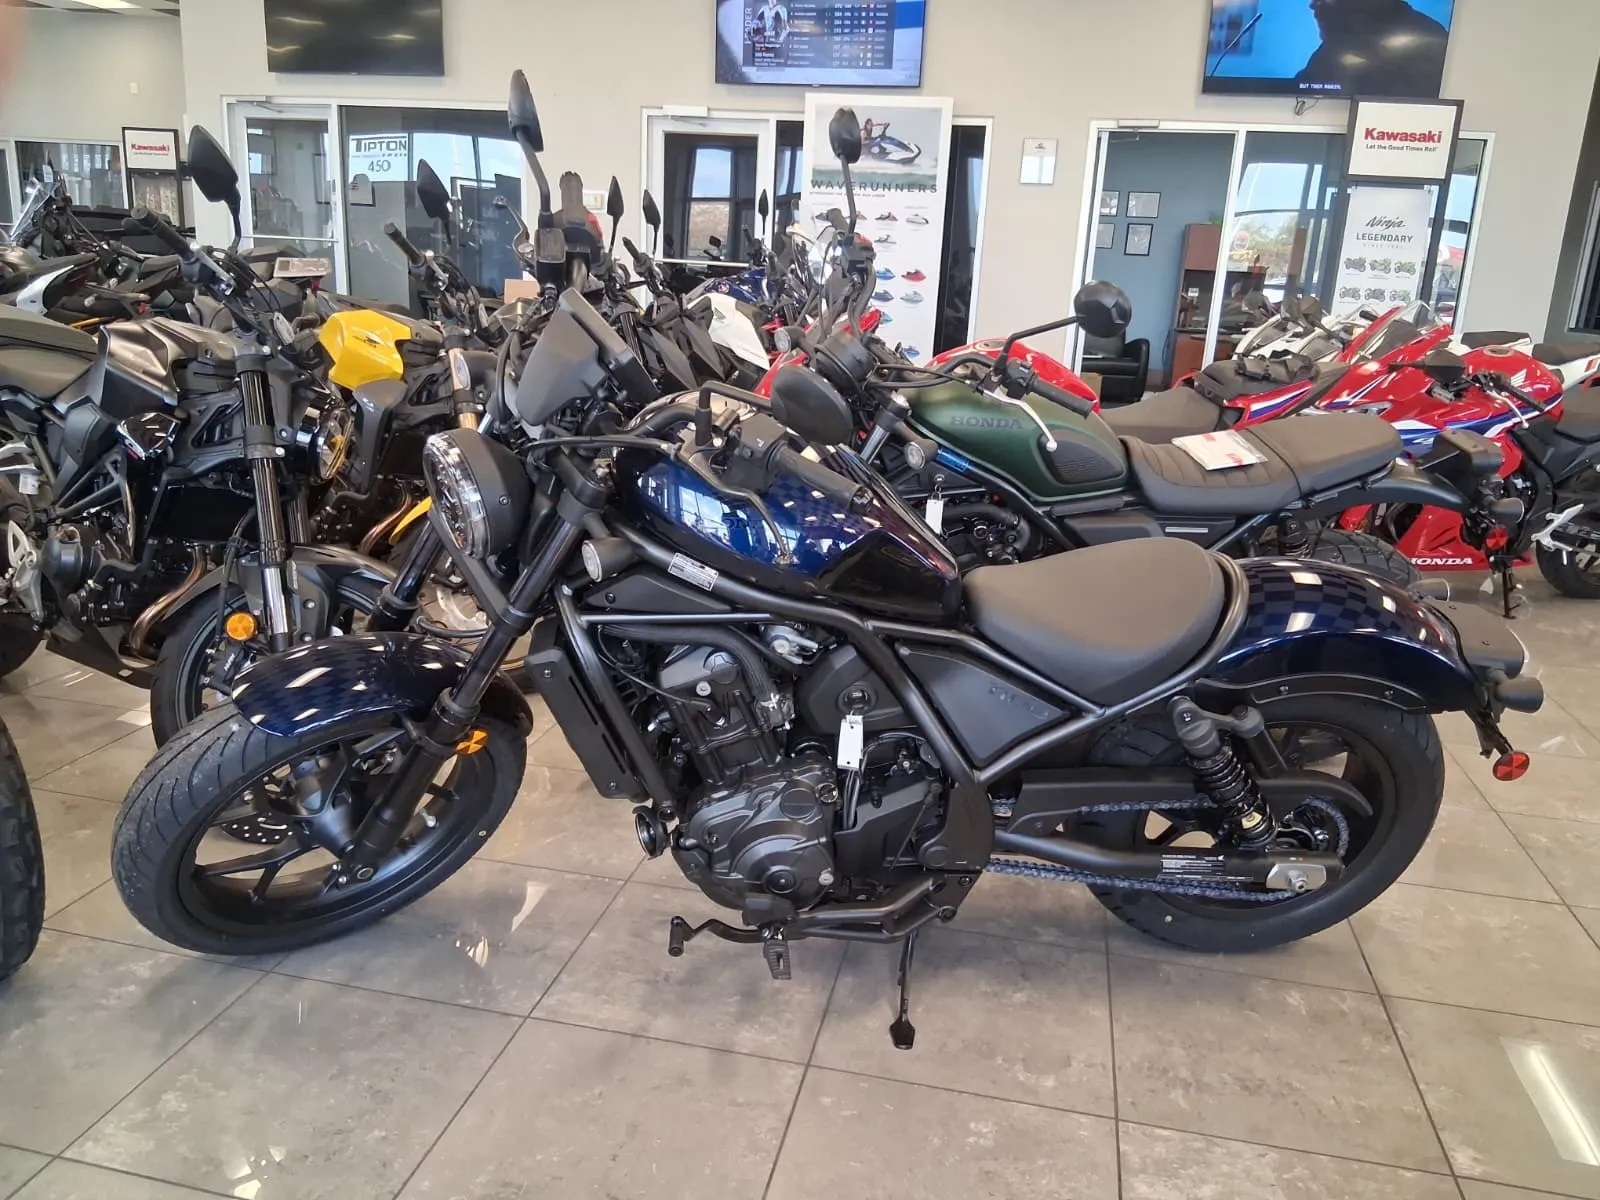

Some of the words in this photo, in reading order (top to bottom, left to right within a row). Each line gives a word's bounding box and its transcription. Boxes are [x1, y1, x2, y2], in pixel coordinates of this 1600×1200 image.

[1364, 127, 1443, 143] Kawasaki
[351, 136, 407, 152] TIPTON
[368, 160, 391, 172] 450
[1365, 215, 1406, 231] Ninja
[1356, 232, 1413, 243] LEGENDARY
[950, 415, 1024, 429] HONDA
